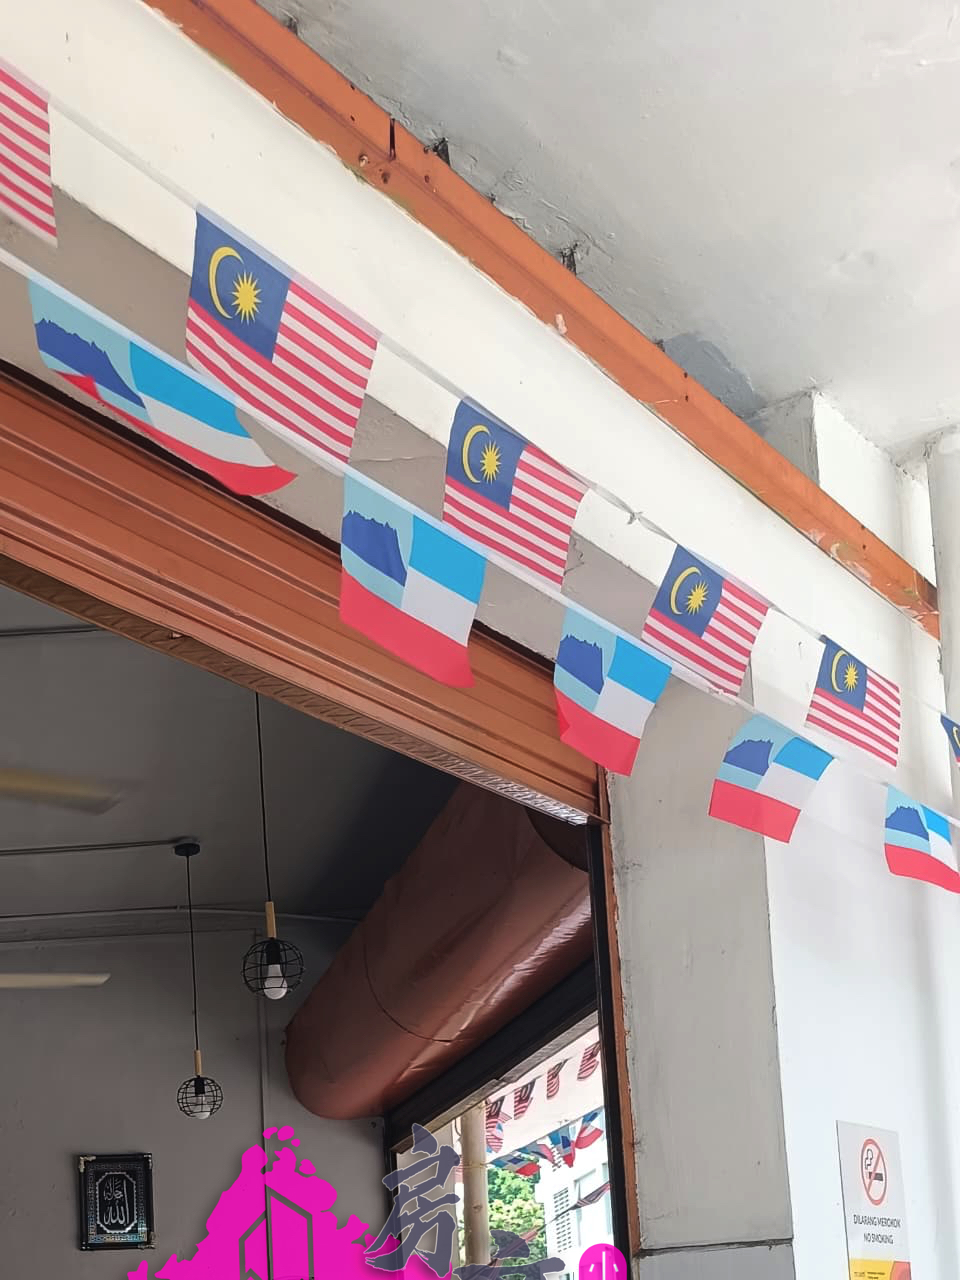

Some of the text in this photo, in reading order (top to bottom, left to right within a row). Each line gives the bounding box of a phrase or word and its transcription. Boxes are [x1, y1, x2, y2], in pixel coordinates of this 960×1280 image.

[853, 1213, 877, 1226] DILARANG
[863, 1233, 894, 1244] NO SMOKING
